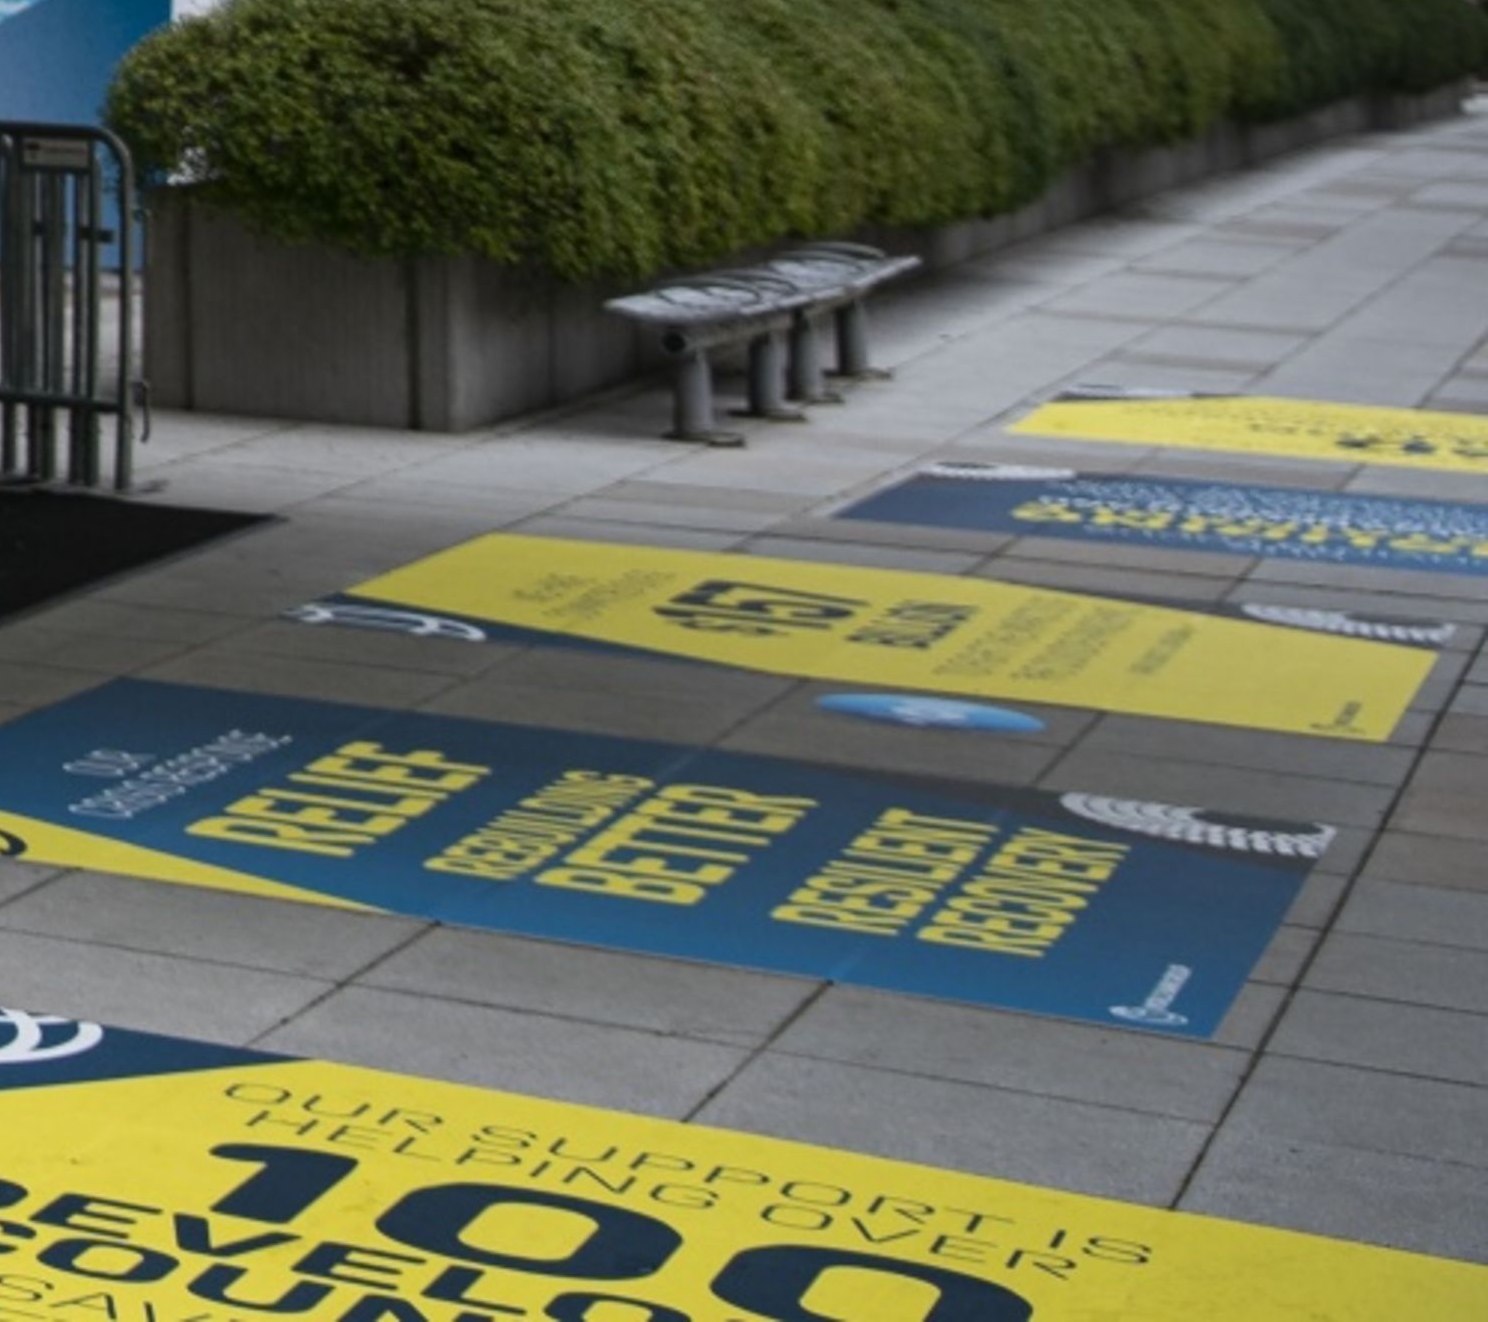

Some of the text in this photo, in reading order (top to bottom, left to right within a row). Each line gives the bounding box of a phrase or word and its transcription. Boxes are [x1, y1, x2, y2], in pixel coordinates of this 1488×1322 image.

[184, 741, 492, 857] RELIEF
[423, 769, 655, 881] REBUILDING
[535, 783, 819, 908] BETTER
[770, 806, 1000, 937] RESILIENT
[917, 826, 1131, 958] RECOVERY
[208, 1142, 1035, 1322] 100
[223, 1083, 1153, 1266] OUR SUPPORT IS
[244, 1110, 1080, 1281] HELPING OVER
